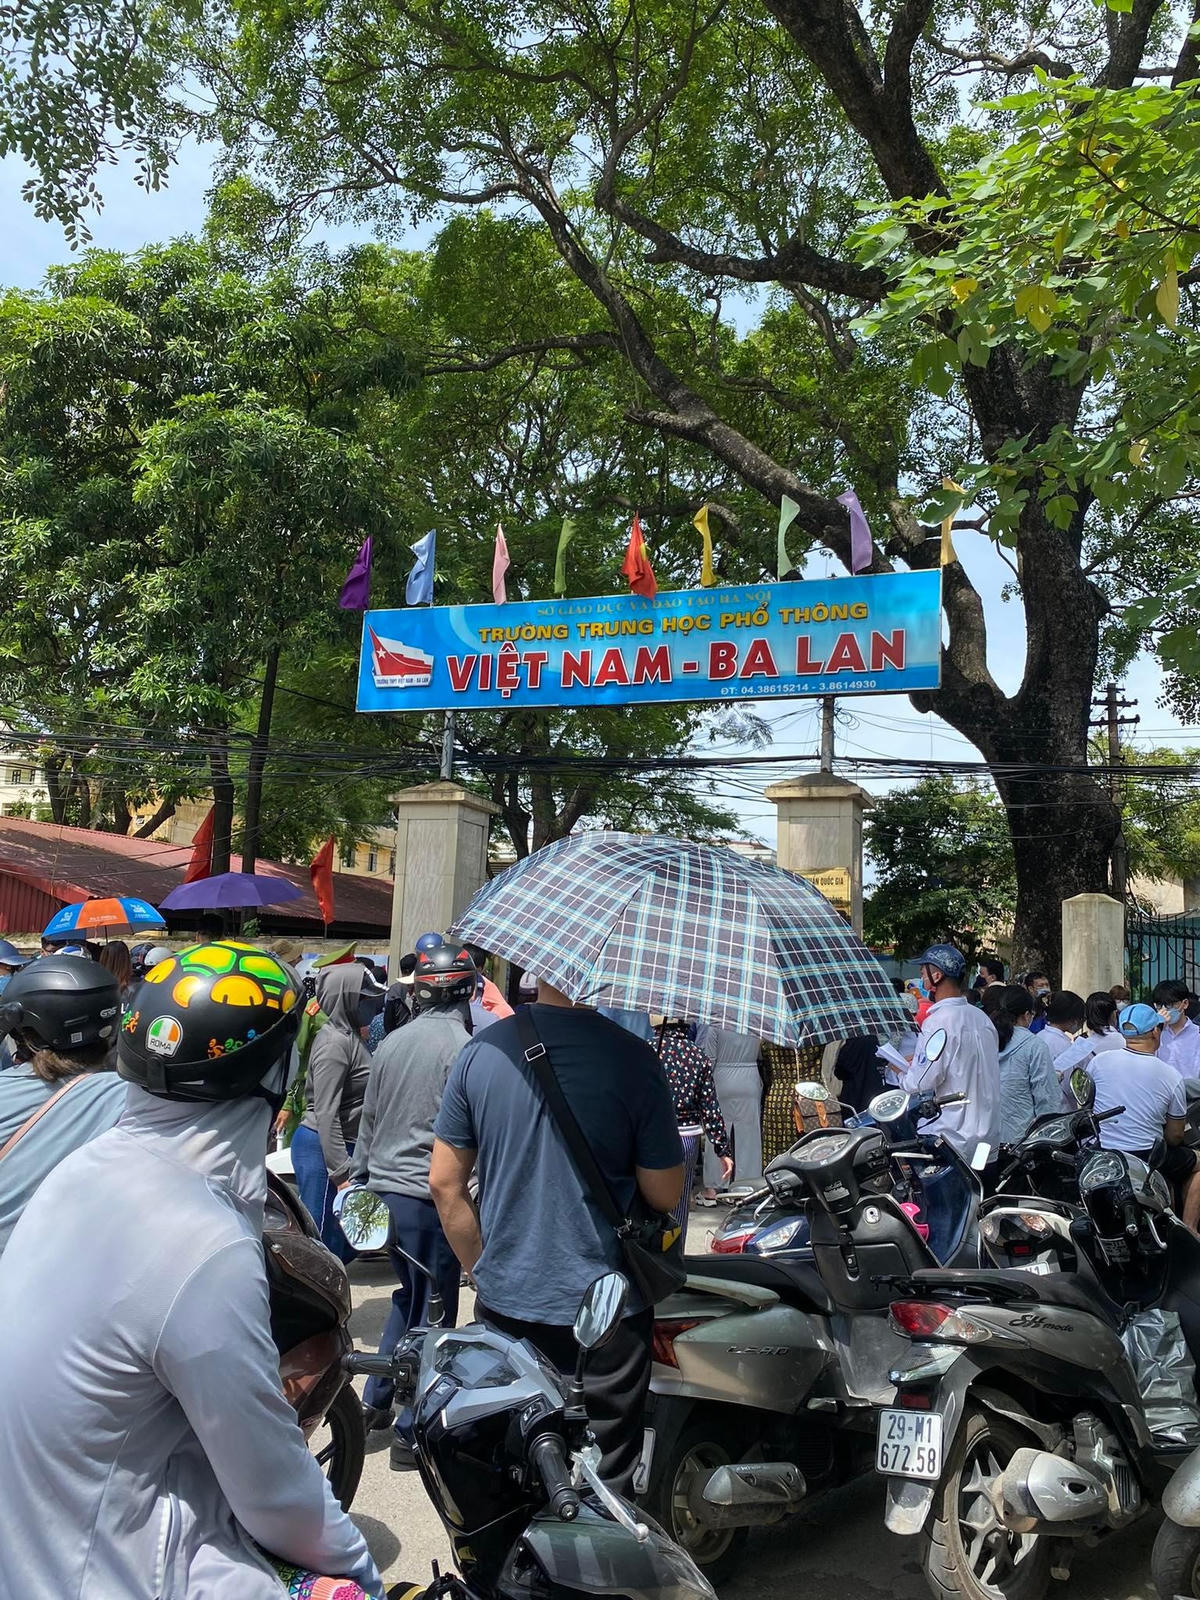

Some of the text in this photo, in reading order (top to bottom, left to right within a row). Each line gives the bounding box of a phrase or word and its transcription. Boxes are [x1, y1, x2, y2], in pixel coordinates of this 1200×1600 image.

[478, 602, 869, 643] TRƯỜNG TRUNG HỌC PHỔ THÔNG
[446, 641, 548, 698] VIỆT
[560, 644, 673, 688] NAM
[707, 638, 780, 681] BA
[795, 628, 907, 677] LAN
[741, 683, 809, 695] 04.38615214
[819, 680, 877, 691] 3.8614930
[150, 1038, 171, 1051] ROMA
[887, 1414, 932, 1443] 29-M1
[880, 1443, 936, 1474] 672.58
